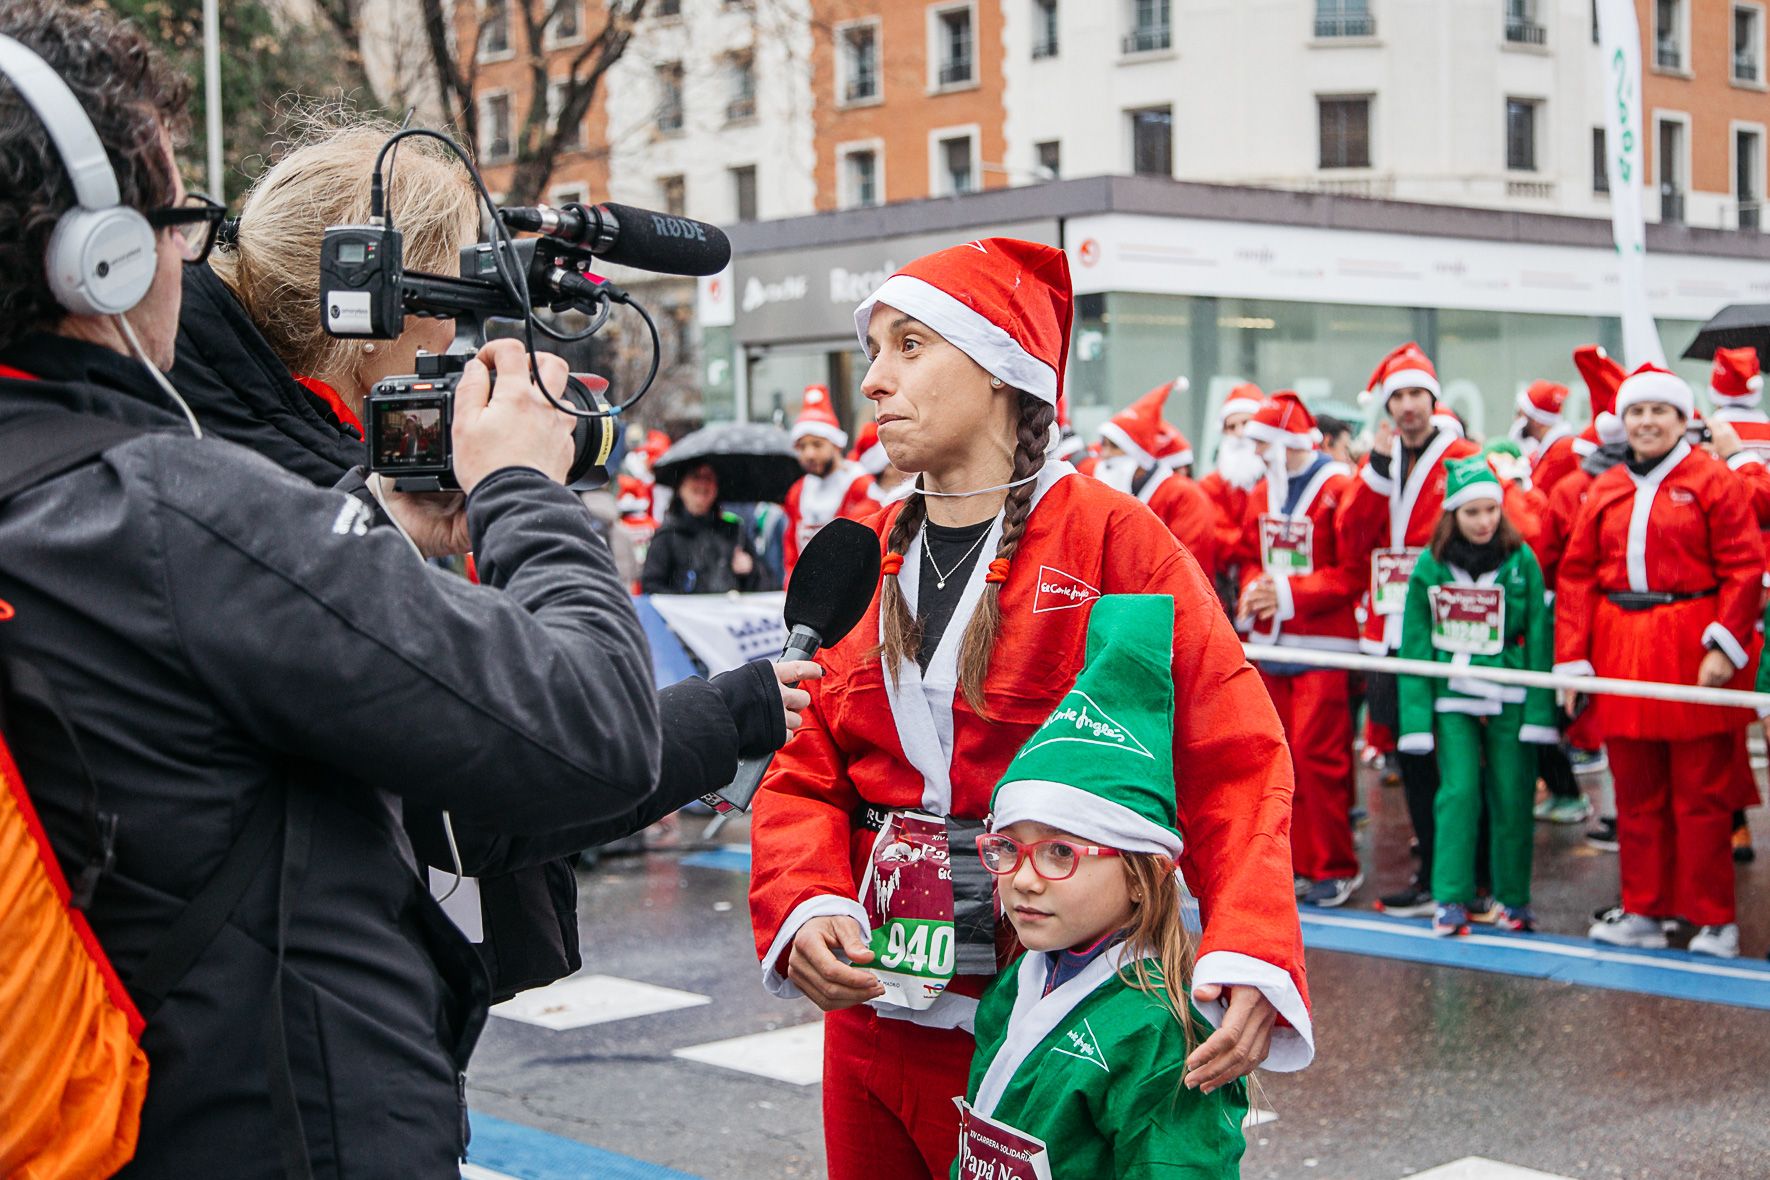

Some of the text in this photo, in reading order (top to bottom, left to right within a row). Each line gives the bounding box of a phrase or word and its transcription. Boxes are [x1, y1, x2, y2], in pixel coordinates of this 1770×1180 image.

[880, 922, 955, 976] 940
[964, 1146, 996, 1180] Papá
[977, 1132, 999, 1150] CARRERA
[1000, 1144, 1032, 1163] SOLIDARIA
